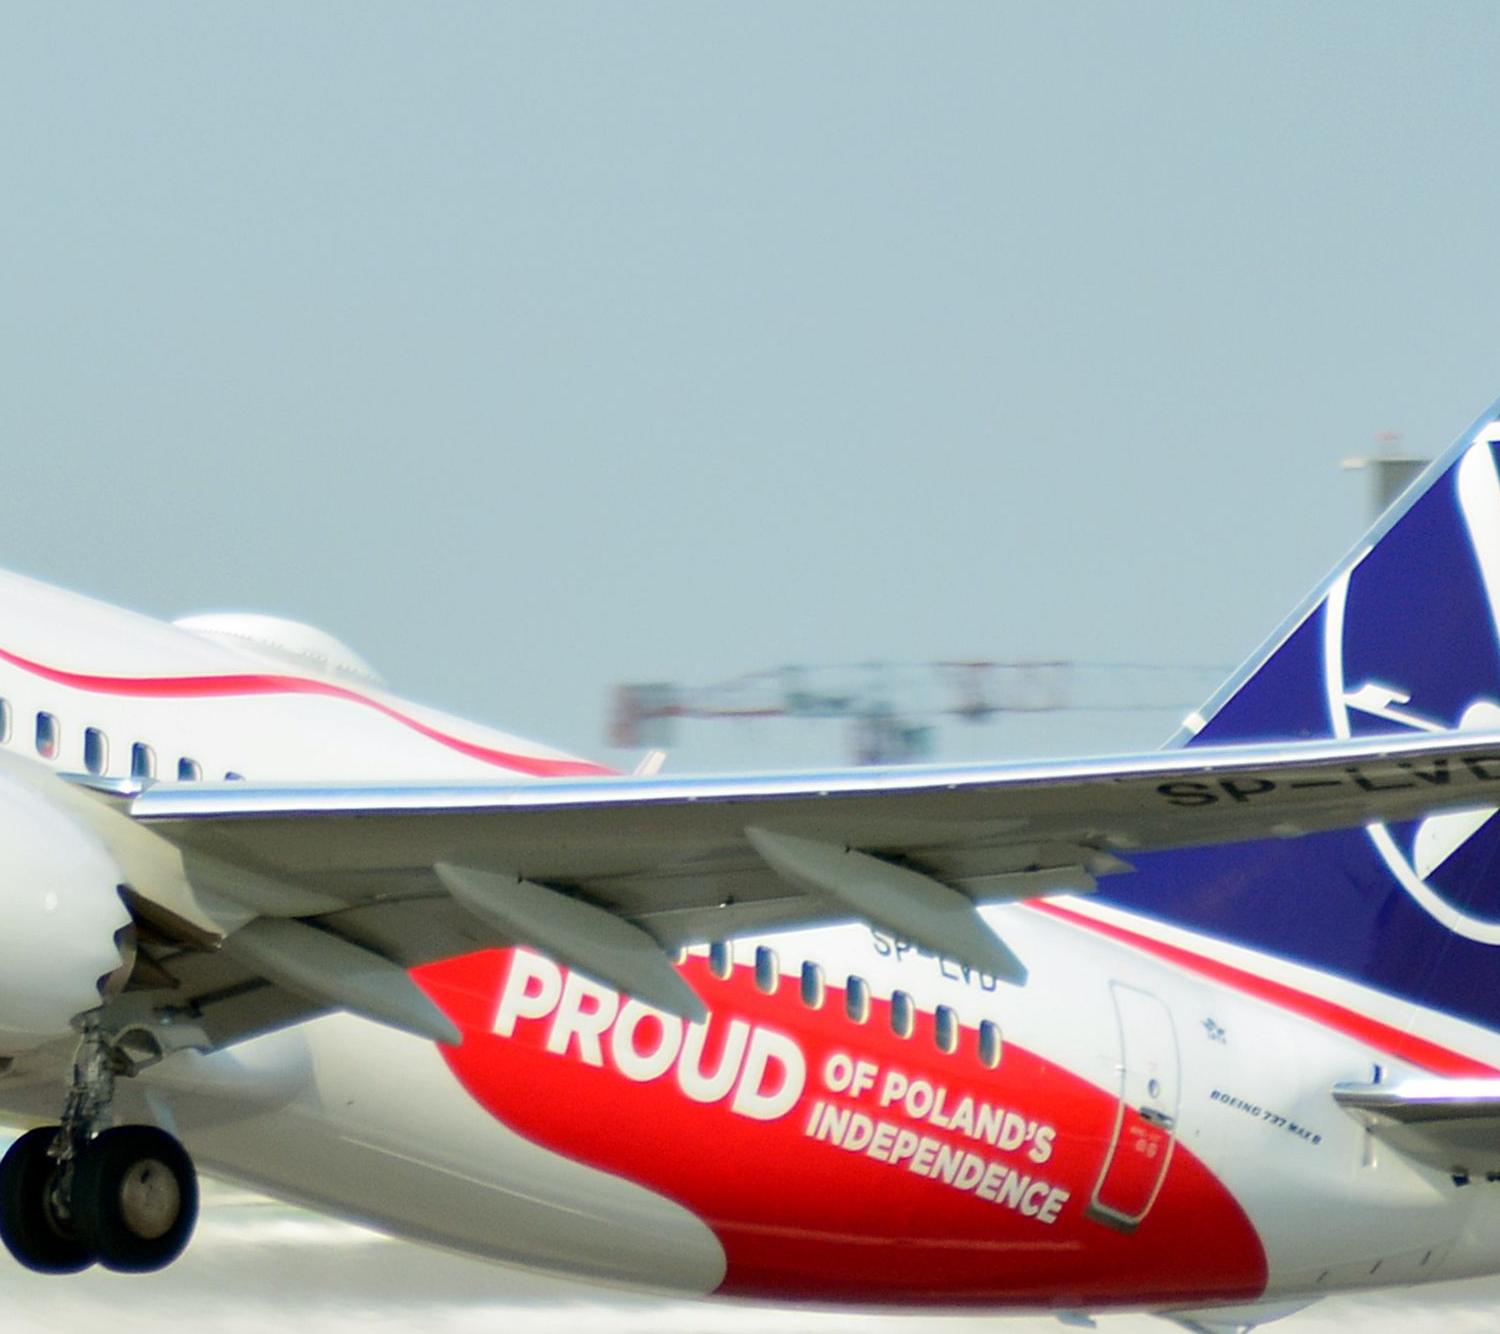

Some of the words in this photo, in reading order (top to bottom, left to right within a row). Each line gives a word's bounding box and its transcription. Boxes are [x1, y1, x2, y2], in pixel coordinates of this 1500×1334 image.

[492, 948, 807, 1121] PROUD
[805, 1101, 1070, 1224] INDEPENDENCE
[824, 1053, 878, 1097] OF
[880, 1071, 1056, 1164] POLAND'S
[1210, 1089, 1261, 1117] BOEING
[1262, 1110, 1287, 1128] 737
